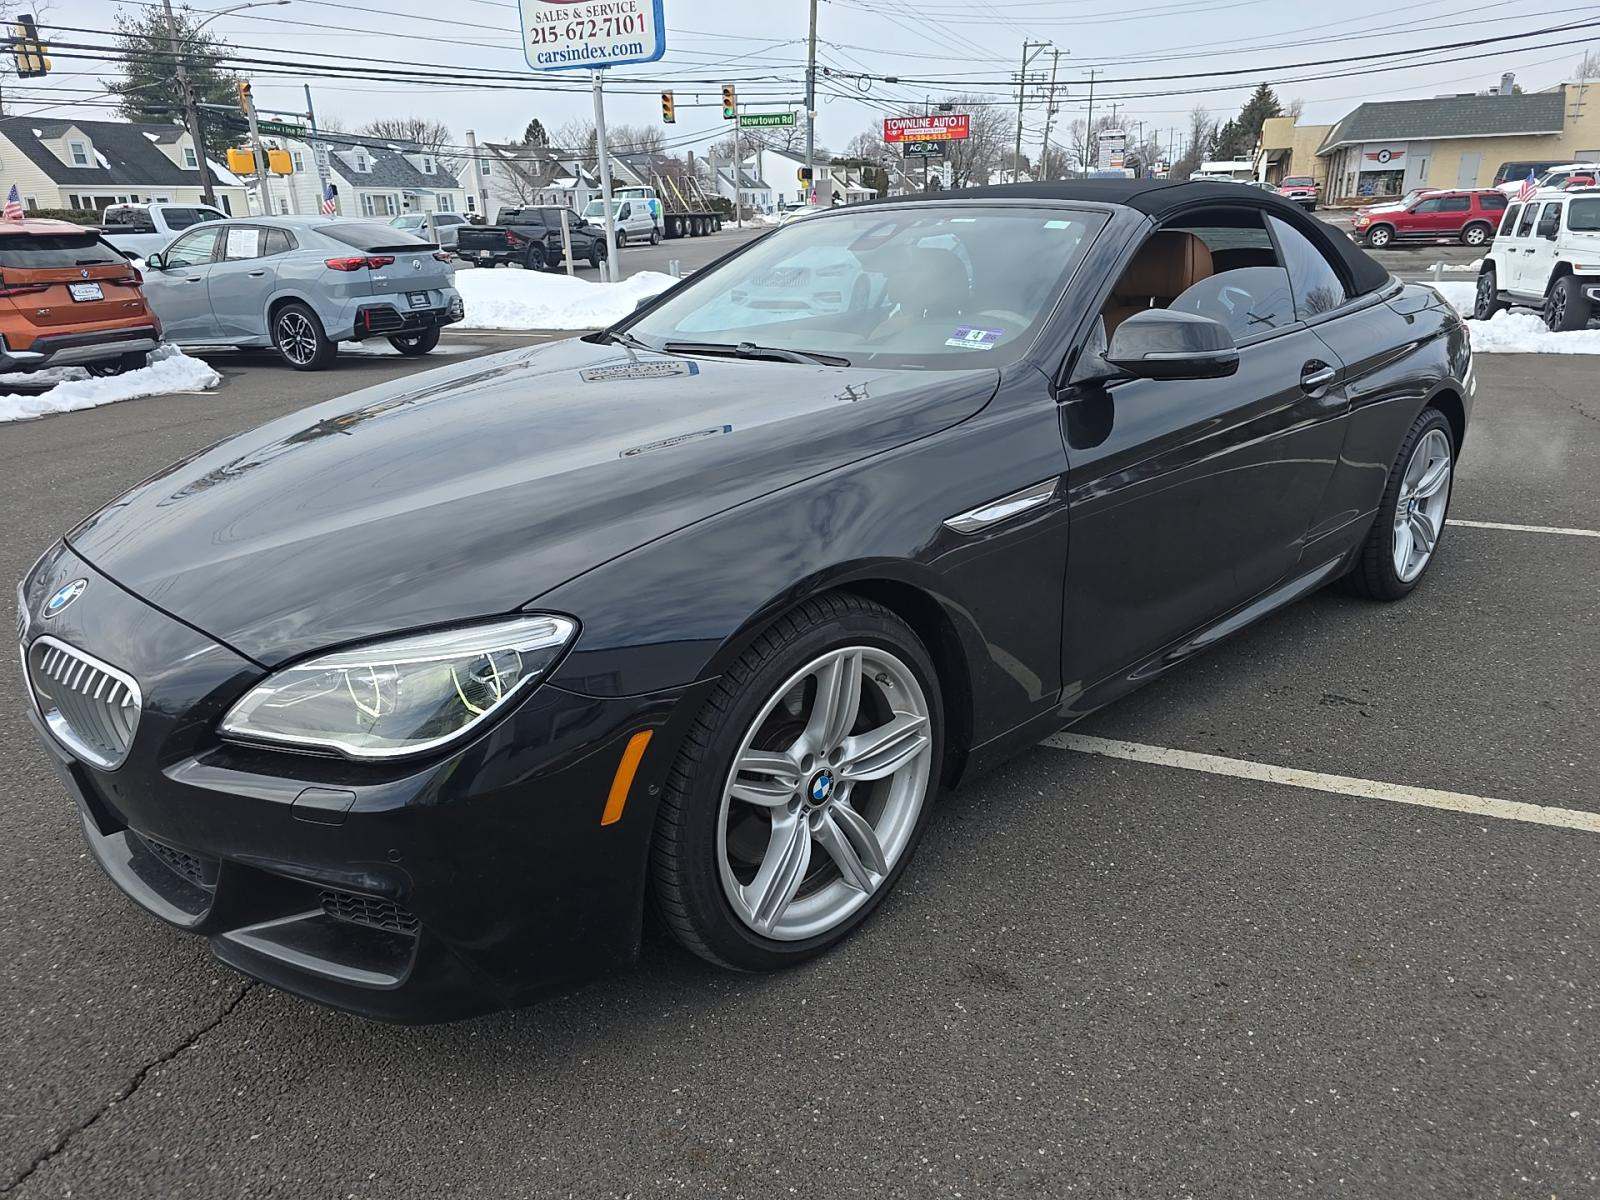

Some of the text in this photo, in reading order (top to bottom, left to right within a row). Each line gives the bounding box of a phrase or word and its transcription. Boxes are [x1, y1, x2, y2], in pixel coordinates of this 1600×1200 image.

[535, 1, 637, 23] SALES & SERVICE
[530, 13, 645, 45] 215-672-7101
[537, 41, 643, 64] carsindex.com
[741, 115, 793, 125] Newtown Rd
[887, 118, 931, 130] TOWNLINE
[933, 117, 957, 127] AUTO
[909, 142, 939, 152] AGORA
